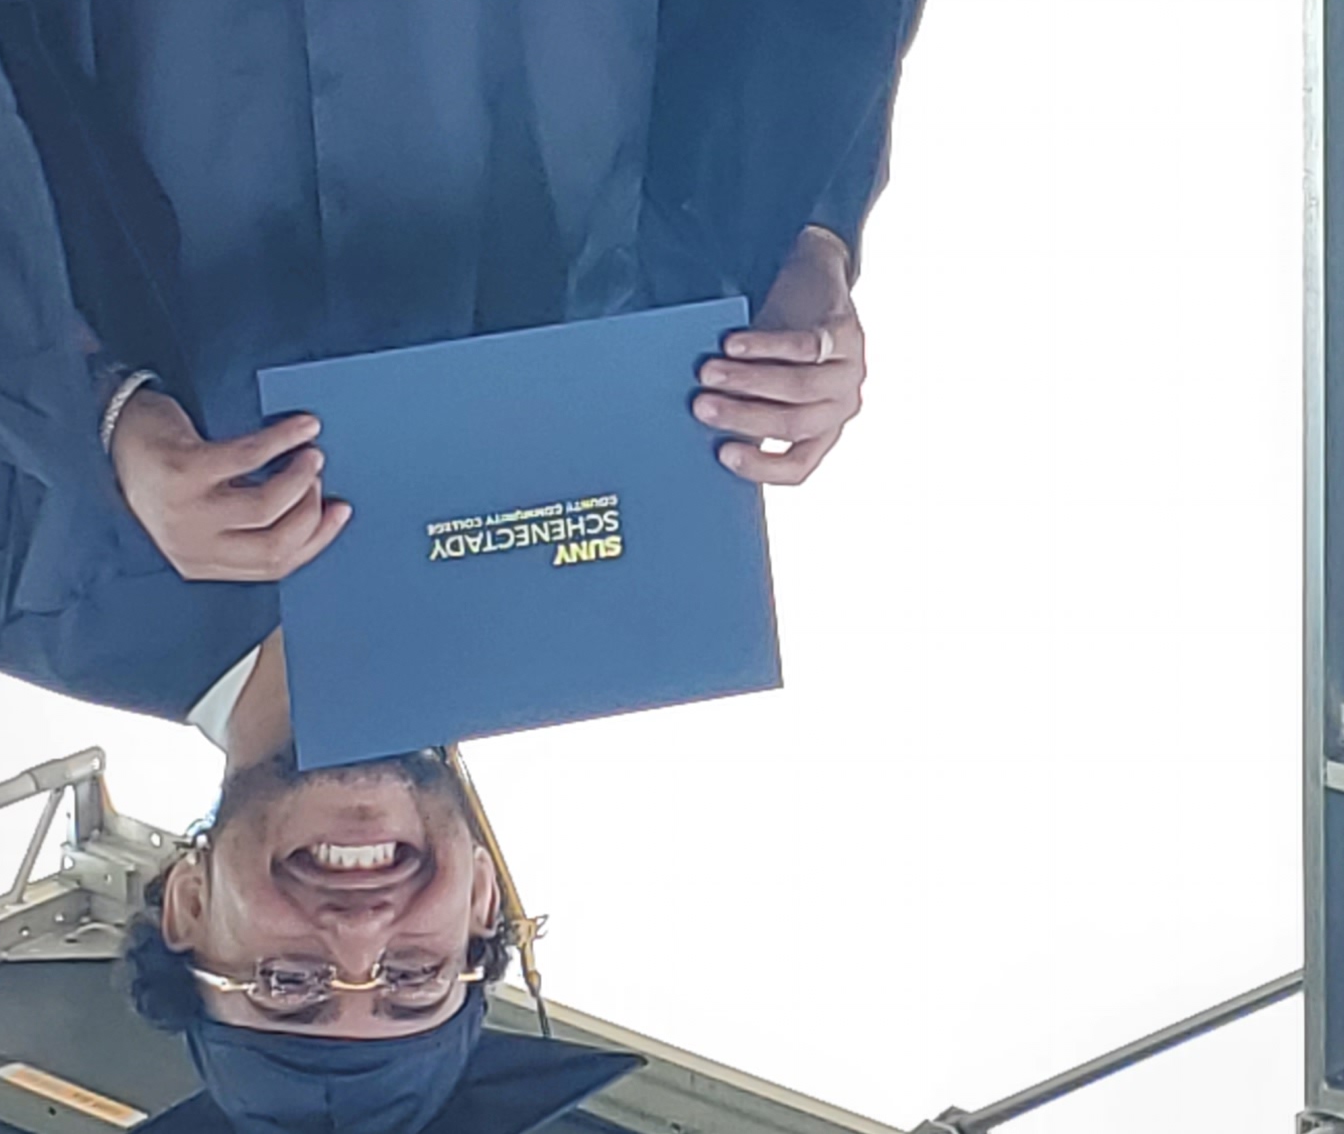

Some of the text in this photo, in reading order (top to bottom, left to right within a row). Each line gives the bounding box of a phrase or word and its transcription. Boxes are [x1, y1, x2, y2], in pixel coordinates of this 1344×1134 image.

[426, 494, 618, 536] COUNTY COMMUNITY COLLEGE
[429, 510, 619, 560] SCHENECTADY
[553, 535, 621, 565] SUNY
